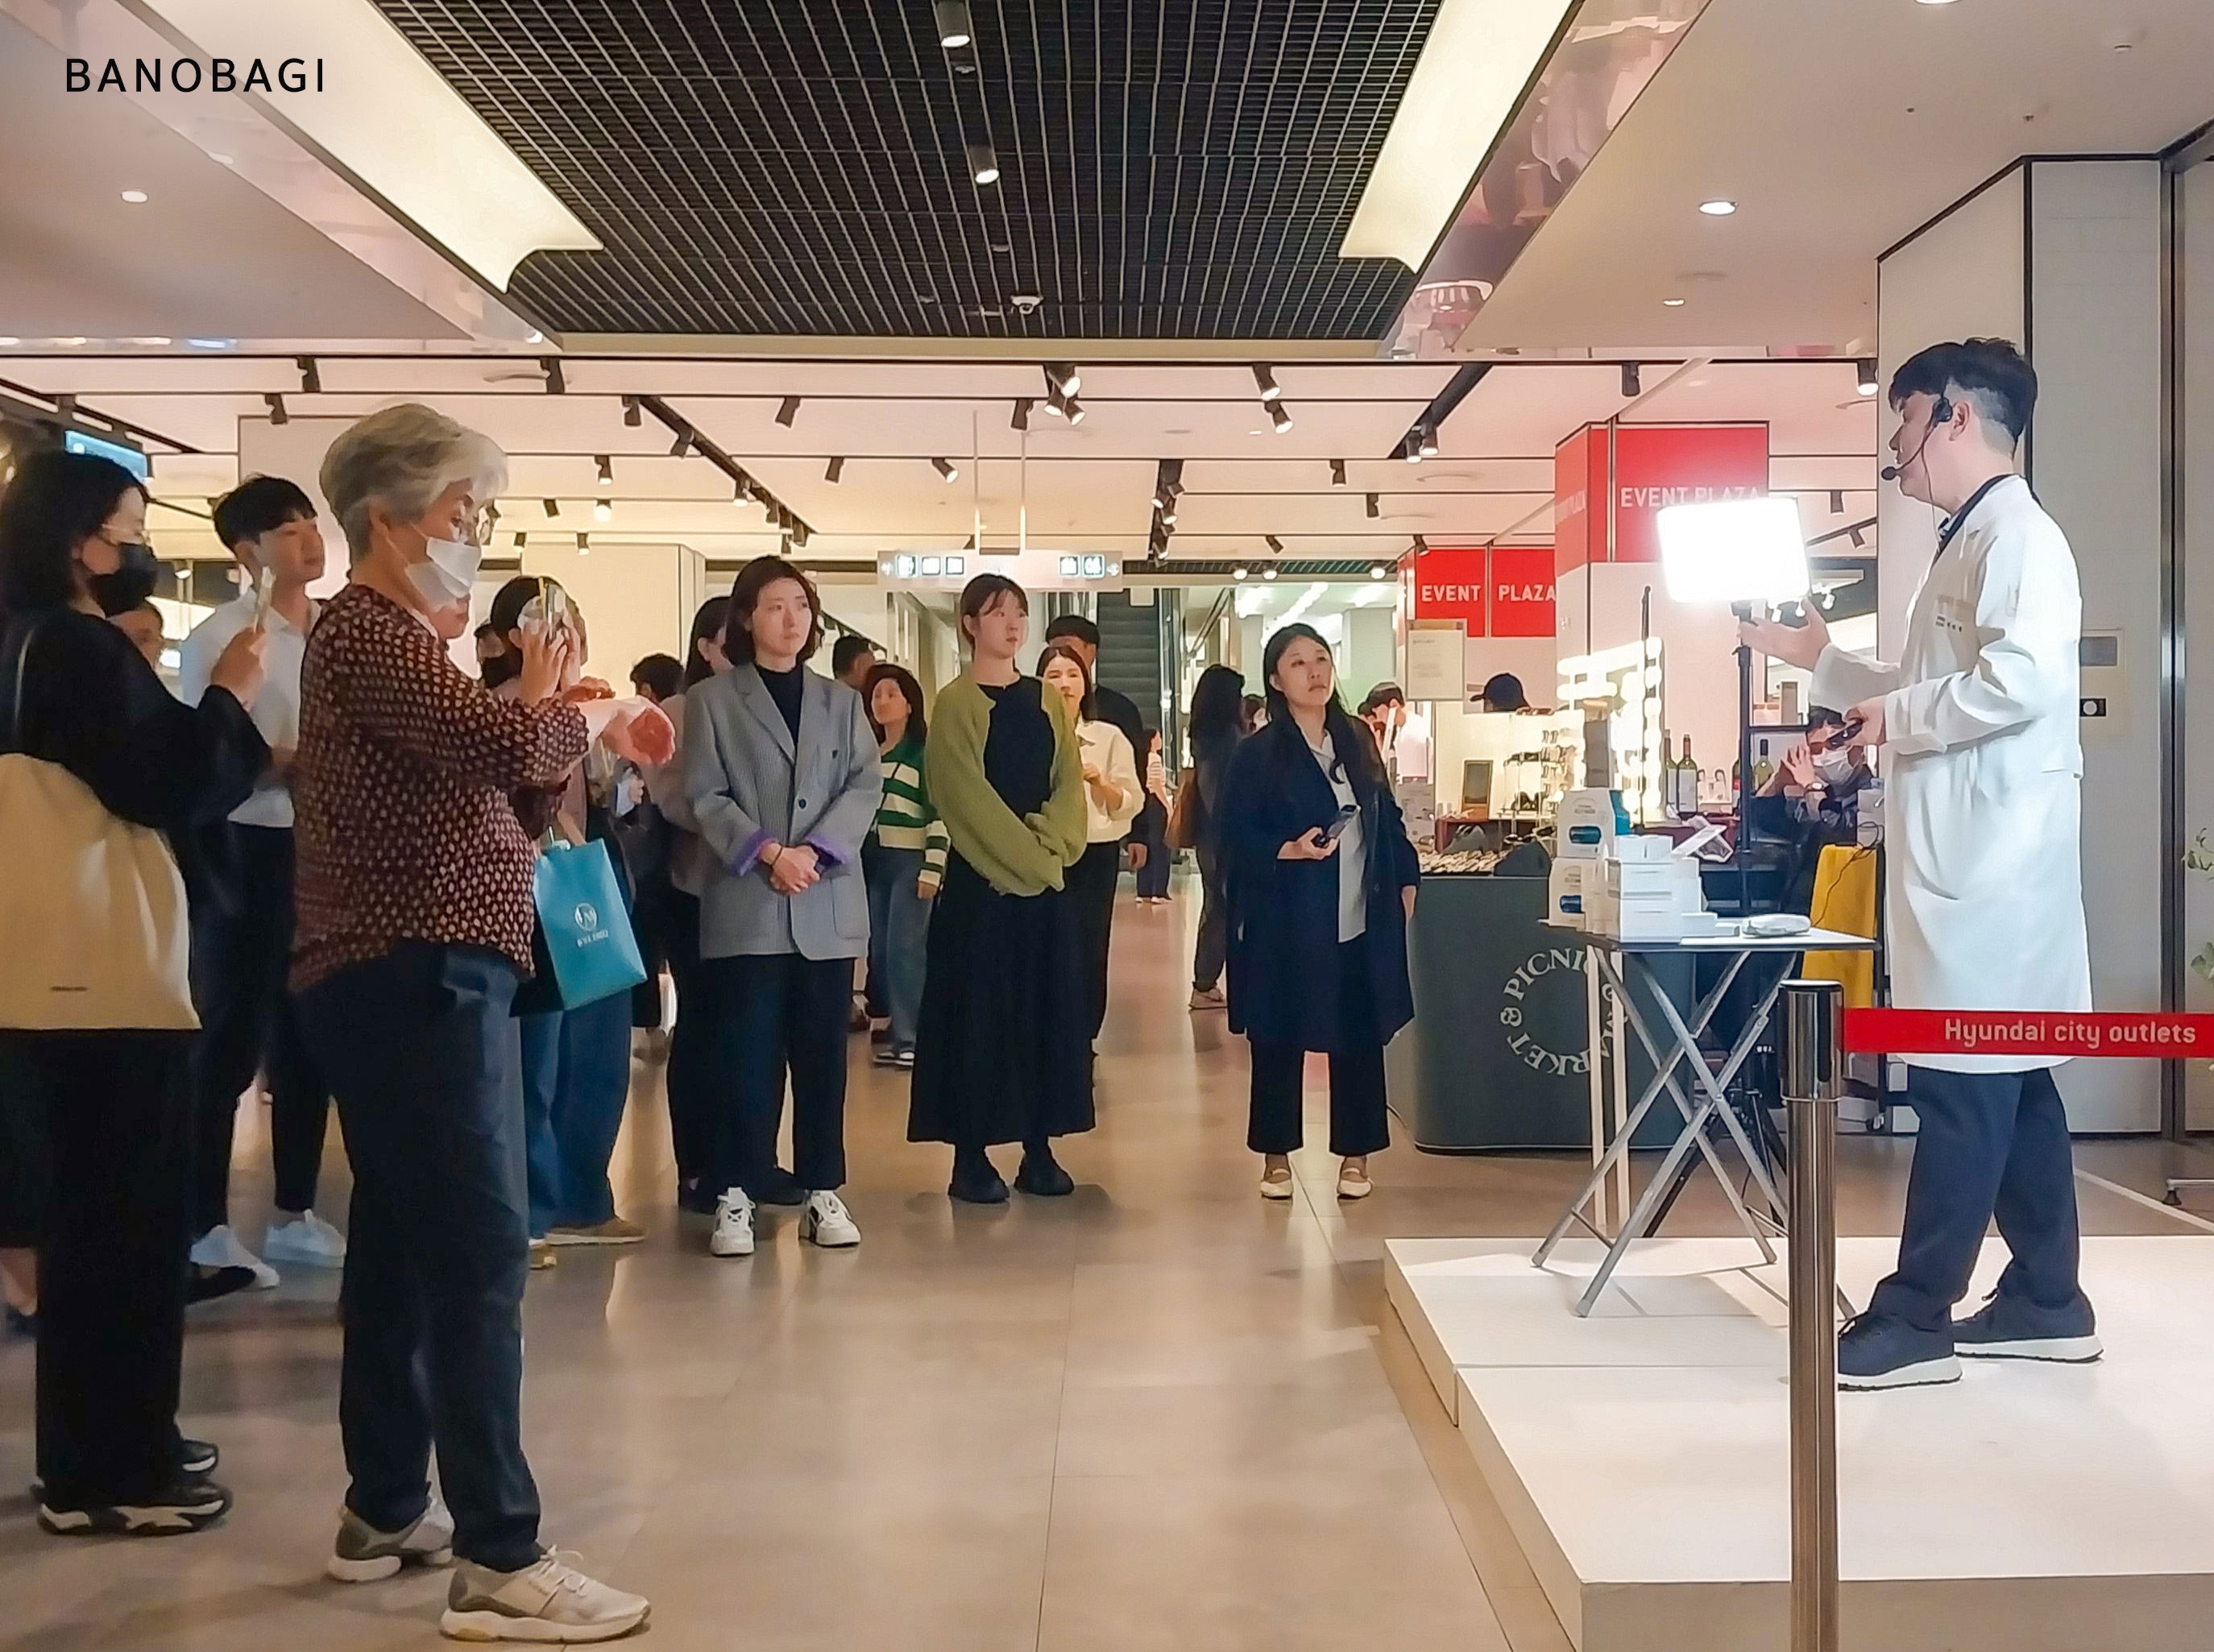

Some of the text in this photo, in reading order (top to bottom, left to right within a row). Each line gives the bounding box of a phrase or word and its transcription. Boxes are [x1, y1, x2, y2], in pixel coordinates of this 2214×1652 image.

[1620, 486, 1688, 507] EVENT
[1421, 584, 1556, 602] EVENT PLAZA
[1503, 948, 1588, 1000] PICNI
[1945, 1018, 2196, 1049] Hyundai city outlets
